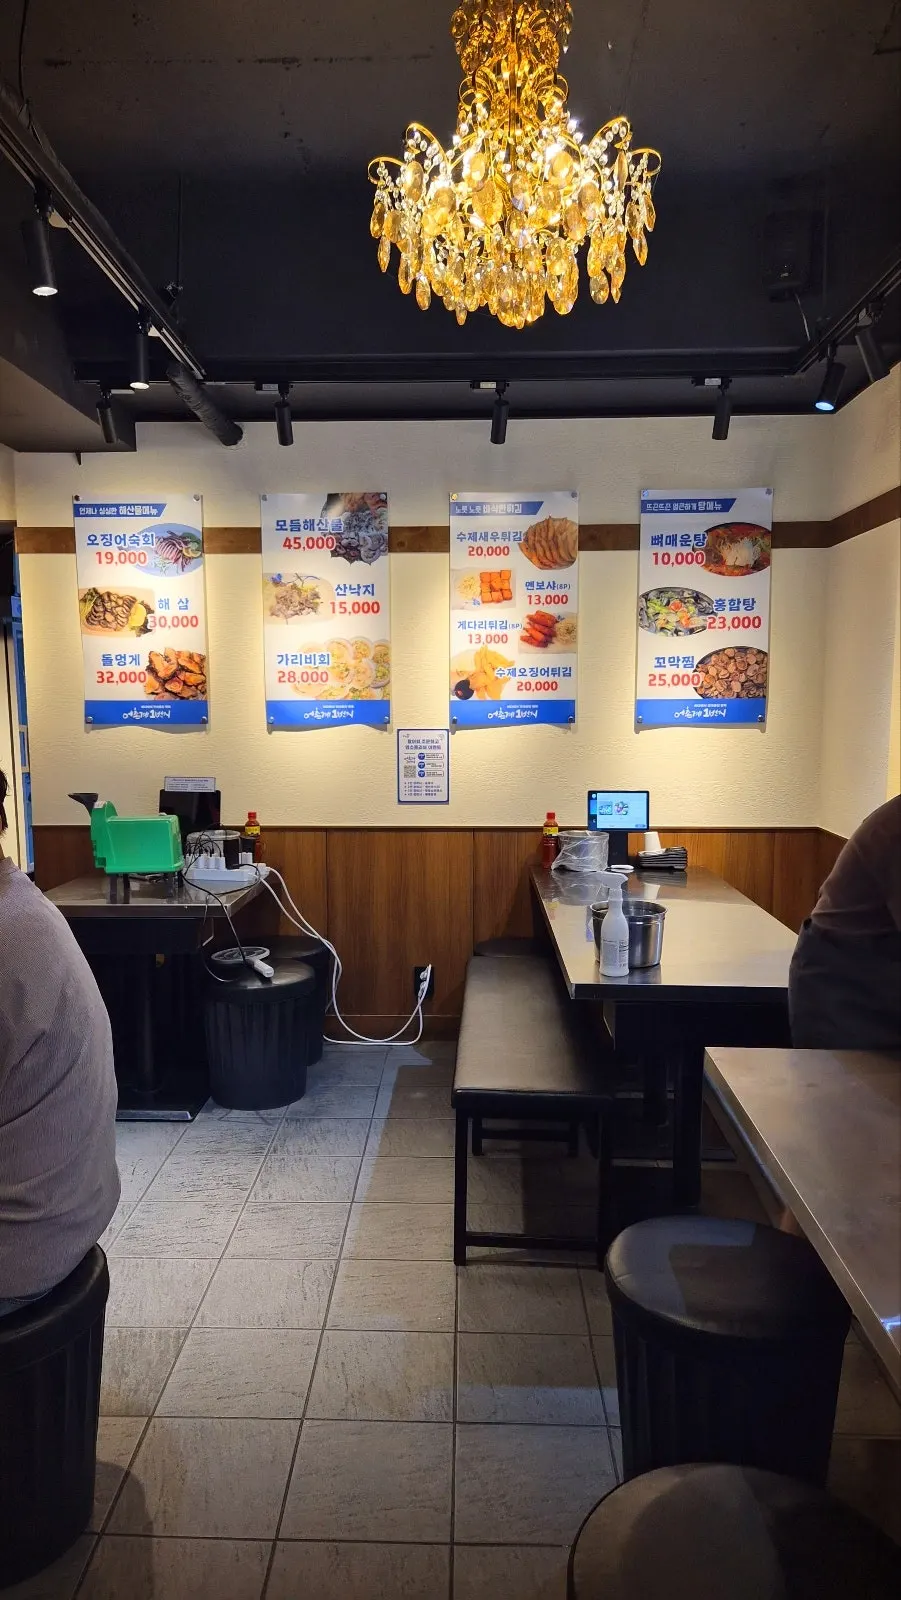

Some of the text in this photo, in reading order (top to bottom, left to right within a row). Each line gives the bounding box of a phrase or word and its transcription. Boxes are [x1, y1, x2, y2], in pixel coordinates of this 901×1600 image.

[119, 505, 158, 516] 해산물메뉴
[698, 501, 722, 511] 탕메뉴
[275, 519, 343, 531] 모듬해산물
[87, 533, 155, 546] 오징어숙회
[456, 531, 523, 542] 수제새우튀김
[650, 533, 706, 547] 뼈매운탕
[283, 537, 335, 551] 45,000
[468, 546, 510, 557] 20,000
[95, 551, 147, 566] 19,000
[652, 552, 704, 567] 10,000
[335, 584, 375, 596] 산낙지
[158, 598, 189, 610] 해 삼
[527, 594, 568, 606] 13,000
[714, 598, 756, 611] 홍합탕
[330, 601, 380, 616] 15,000
[149, 615, 199, 629] 30,000
[707, 616, 761, 630] 23,000
[467, 633, 508, 645] 13,000
[101, 653, 141, 666] 돌멍게
[277, 653, 330, 666] 가리비회
[654, 655, 695, 668] 꼬막찜
[96, 671, 147, 685] 32,000
[277, 671, 329, 684] 28,000
[496, 666, 572, 677] 수제오징어튀김
[516, 681, 558, 692] 20,000
[648, 673, 701, 688] 25,000
